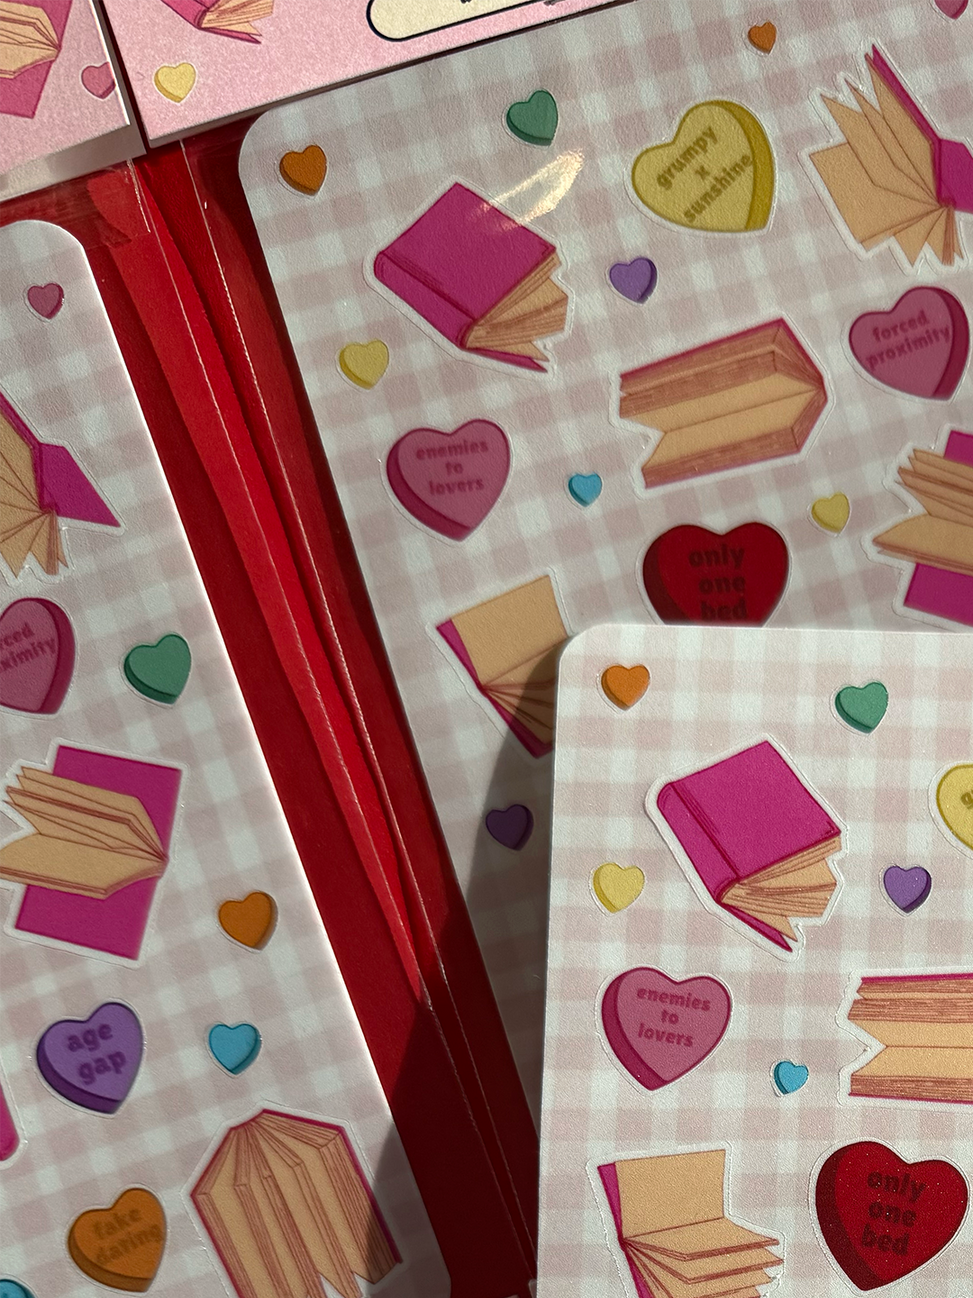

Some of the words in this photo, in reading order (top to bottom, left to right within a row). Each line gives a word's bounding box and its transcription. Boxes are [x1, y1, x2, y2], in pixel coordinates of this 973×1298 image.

[656, 125, 719, 188] grumpy
[694, 164, 711, 180] x
[684, 154, 754, 223] sunshine
[872, 309, 930, 342] forced
[863, 325, 950, 371] proximity
[416, 438, 489, 461] enemies
[446, 461, 464, 477] to
[430, 478, 486, 496] lovers
[688, 542, 745, 569] only
[698, 577, 746, 595] one
[0, 622, 35, 650] ced
[0, 638, 57, 672] ximity
[637, 988, 711, 1012] enemies
[660, 1008, 679, 1024] to
[67, 1022, 114, 1053] age
[638, 1022, 694, 1048] lovers
[77, 1051, 128, 1086] gap
[866, 1171, 926, 1204] only
[93, 1207, 144, 1240] fake
[867, 1201, 918, 1229] one
[94, 1222, 162, 1267] dating
[861, 1222, 910, 1257] bed
